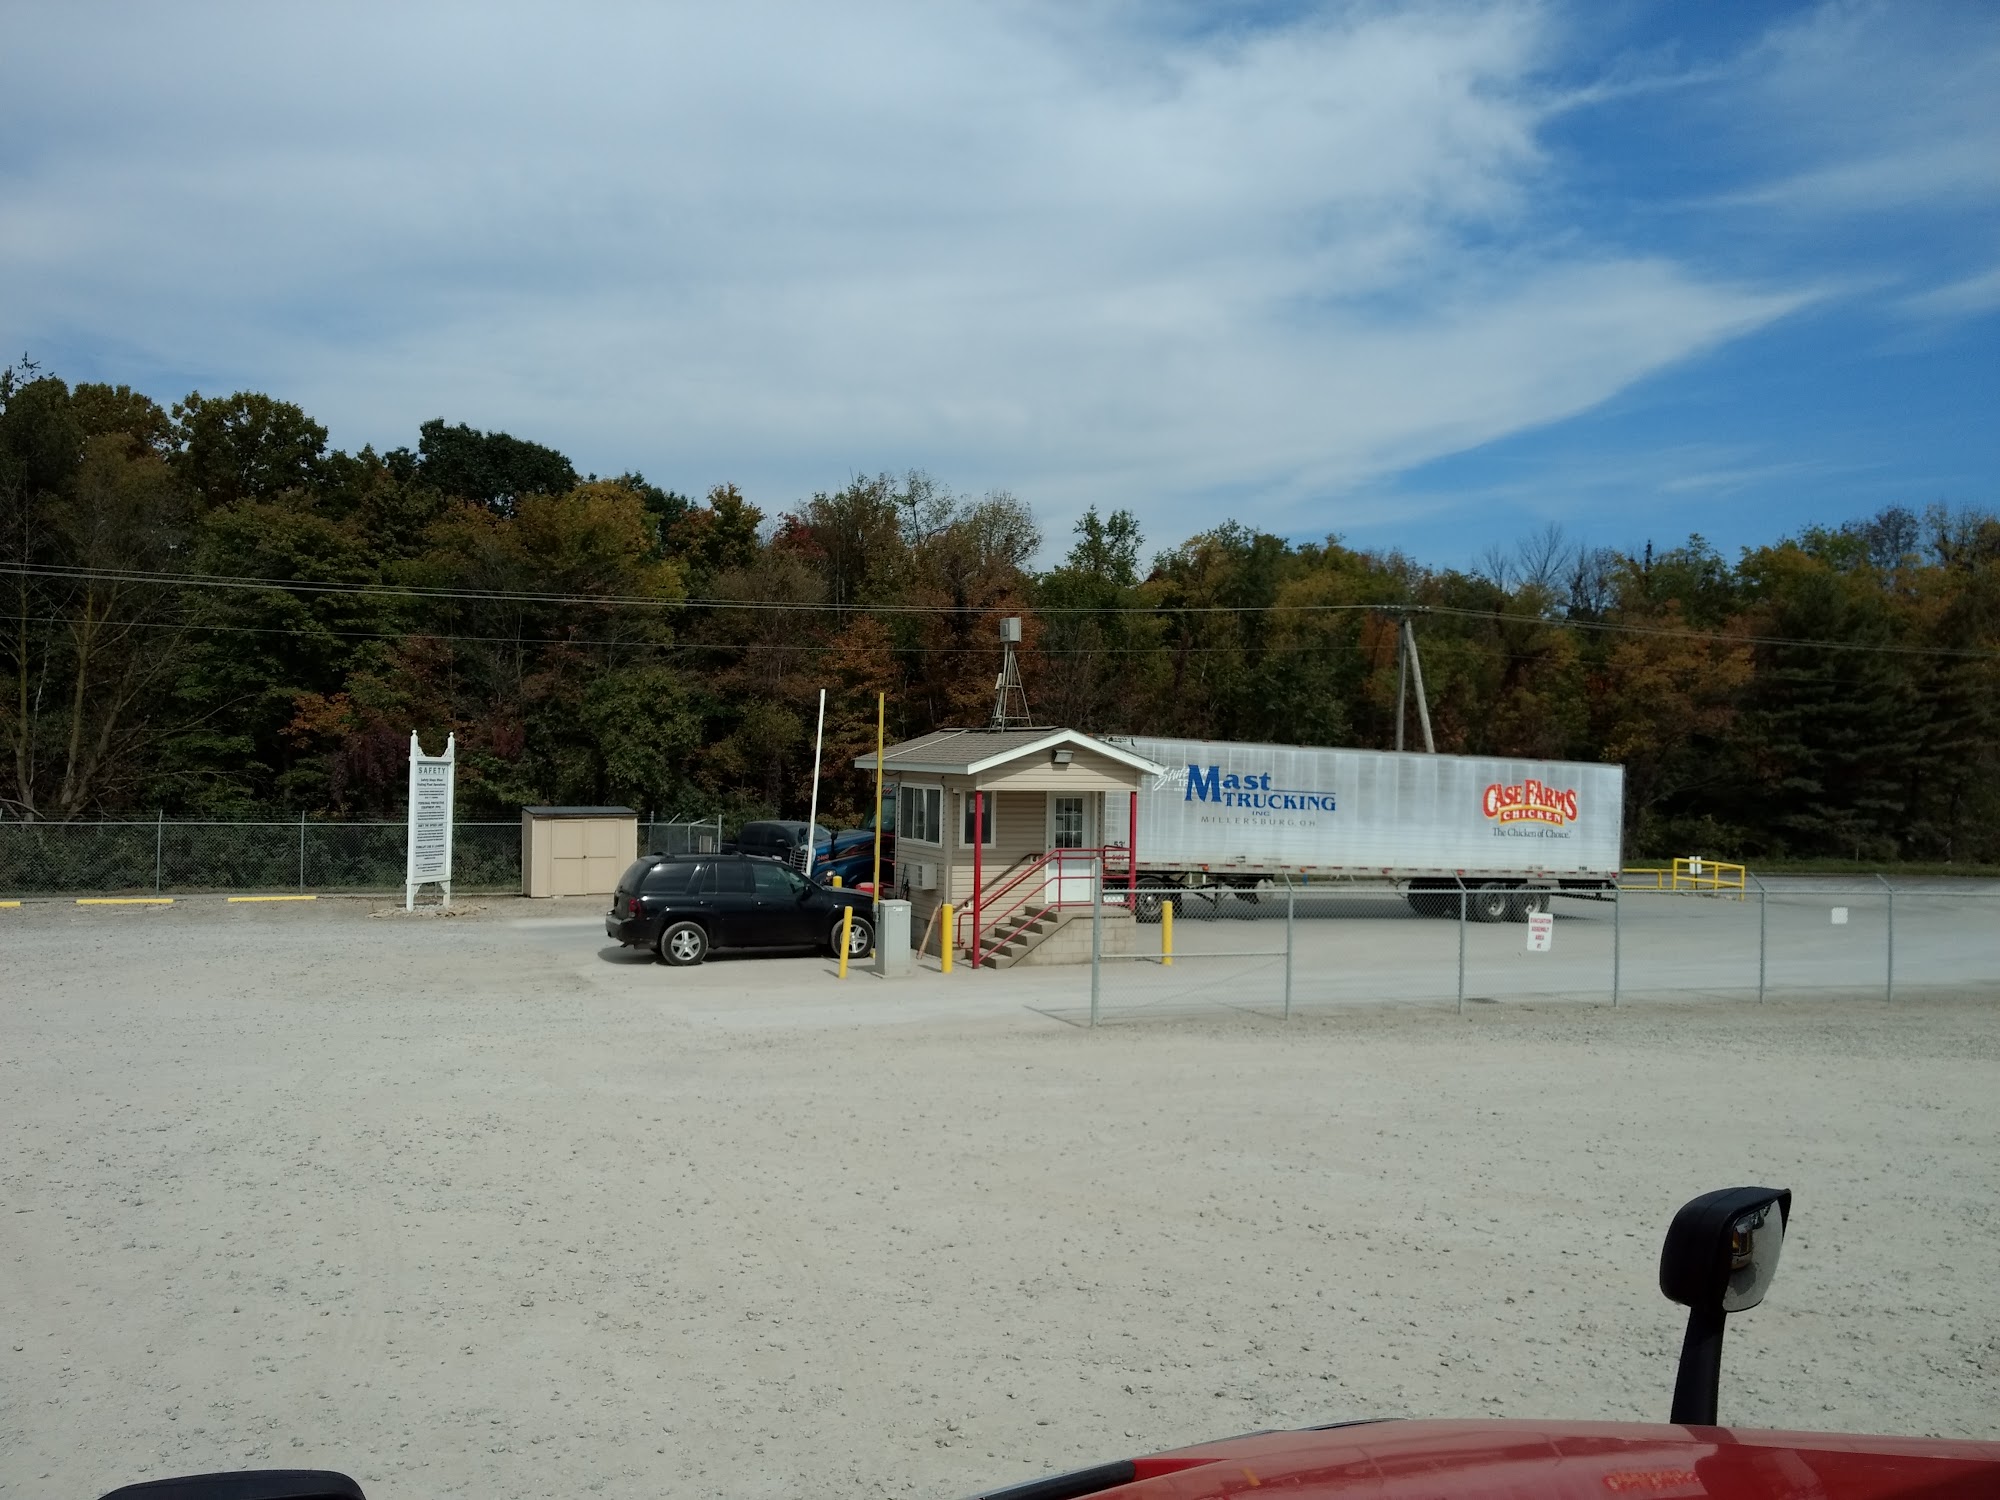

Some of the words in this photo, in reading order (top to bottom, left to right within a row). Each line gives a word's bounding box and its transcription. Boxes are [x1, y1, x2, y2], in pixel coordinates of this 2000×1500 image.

[1184, 764, 1271, 803] Mast
[1222, 792, 1336, 812] TRUCKING
[1503, 811, 1561, 824] CHICKEN
[1492, 828, 1506, 837] The
[1507, 829, 1536, 837] Chicken
[1537, 830, 1544, 838] of
